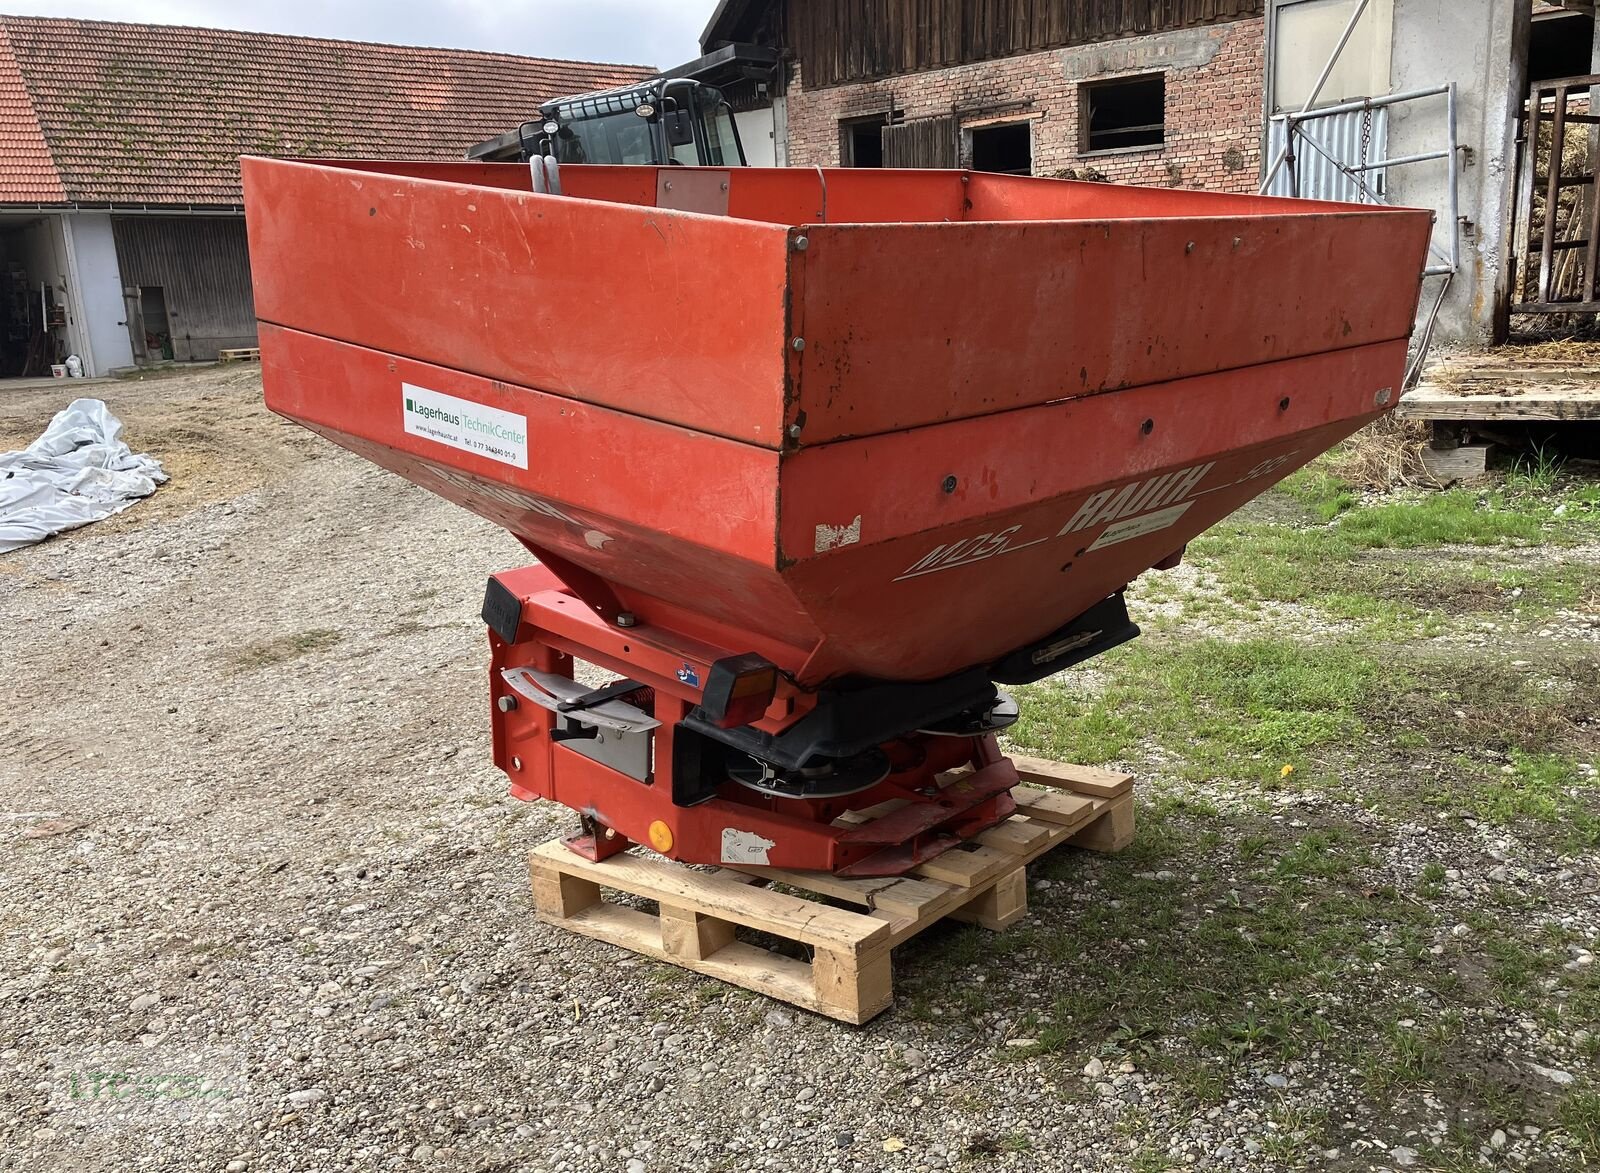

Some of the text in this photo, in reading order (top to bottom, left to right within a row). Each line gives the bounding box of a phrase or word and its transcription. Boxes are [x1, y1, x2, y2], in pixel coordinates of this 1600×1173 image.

[414, 400, 526, 445] Lagerhaus TechnikCenter
[1056, 461, 1217, 538] RAUCH
